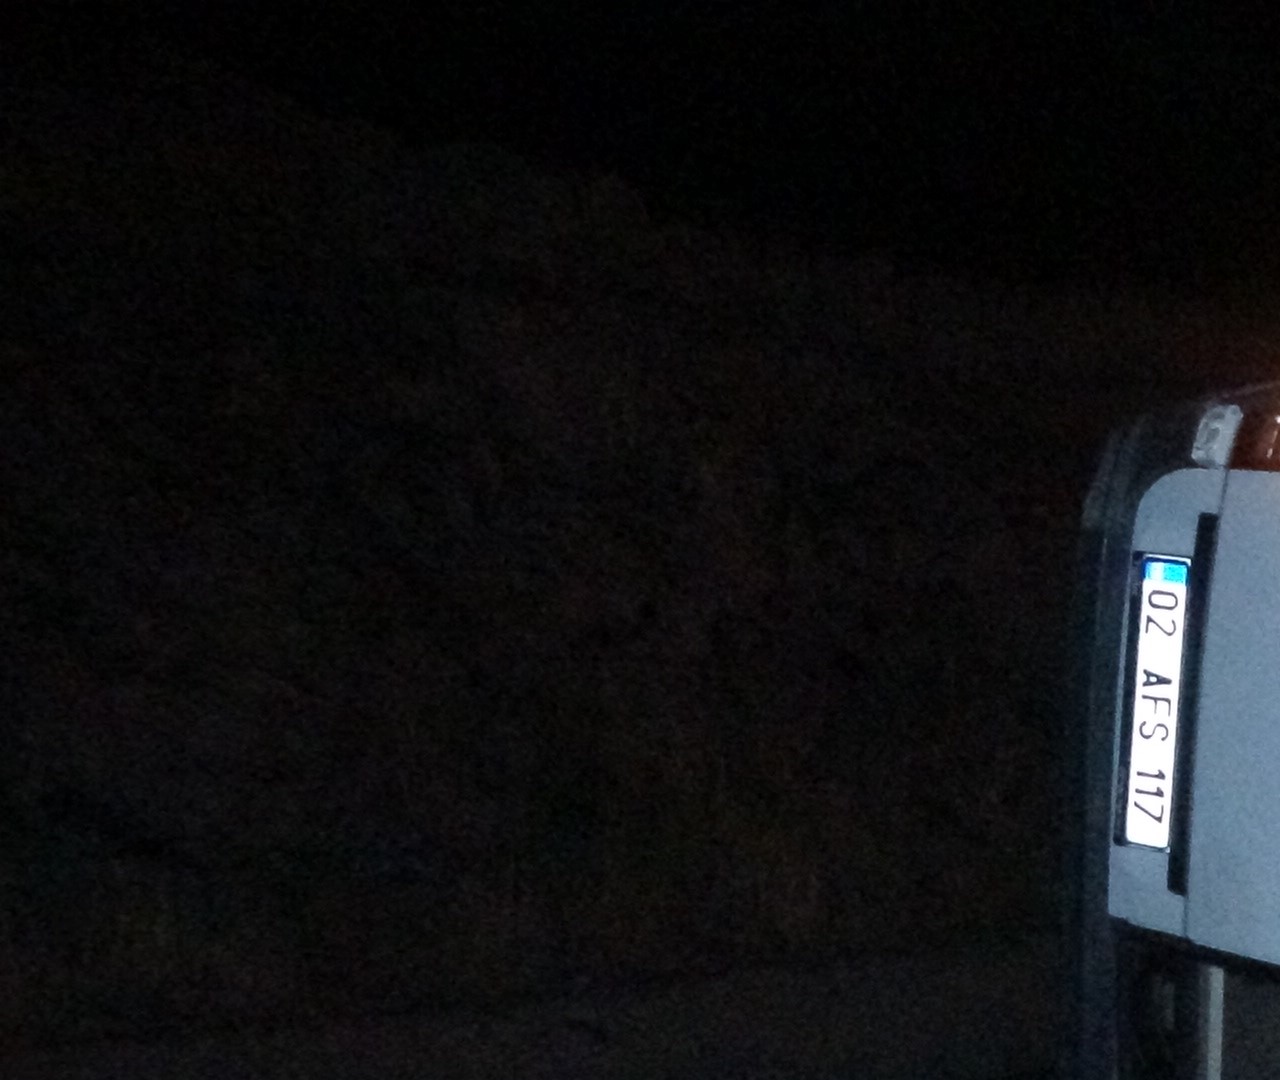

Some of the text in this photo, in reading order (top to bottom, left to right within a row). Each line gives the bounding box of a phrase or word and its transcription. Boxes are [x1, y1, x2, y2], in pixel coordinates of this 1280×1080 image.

[1134, 590, 1179, 824] 02 AFS 117
